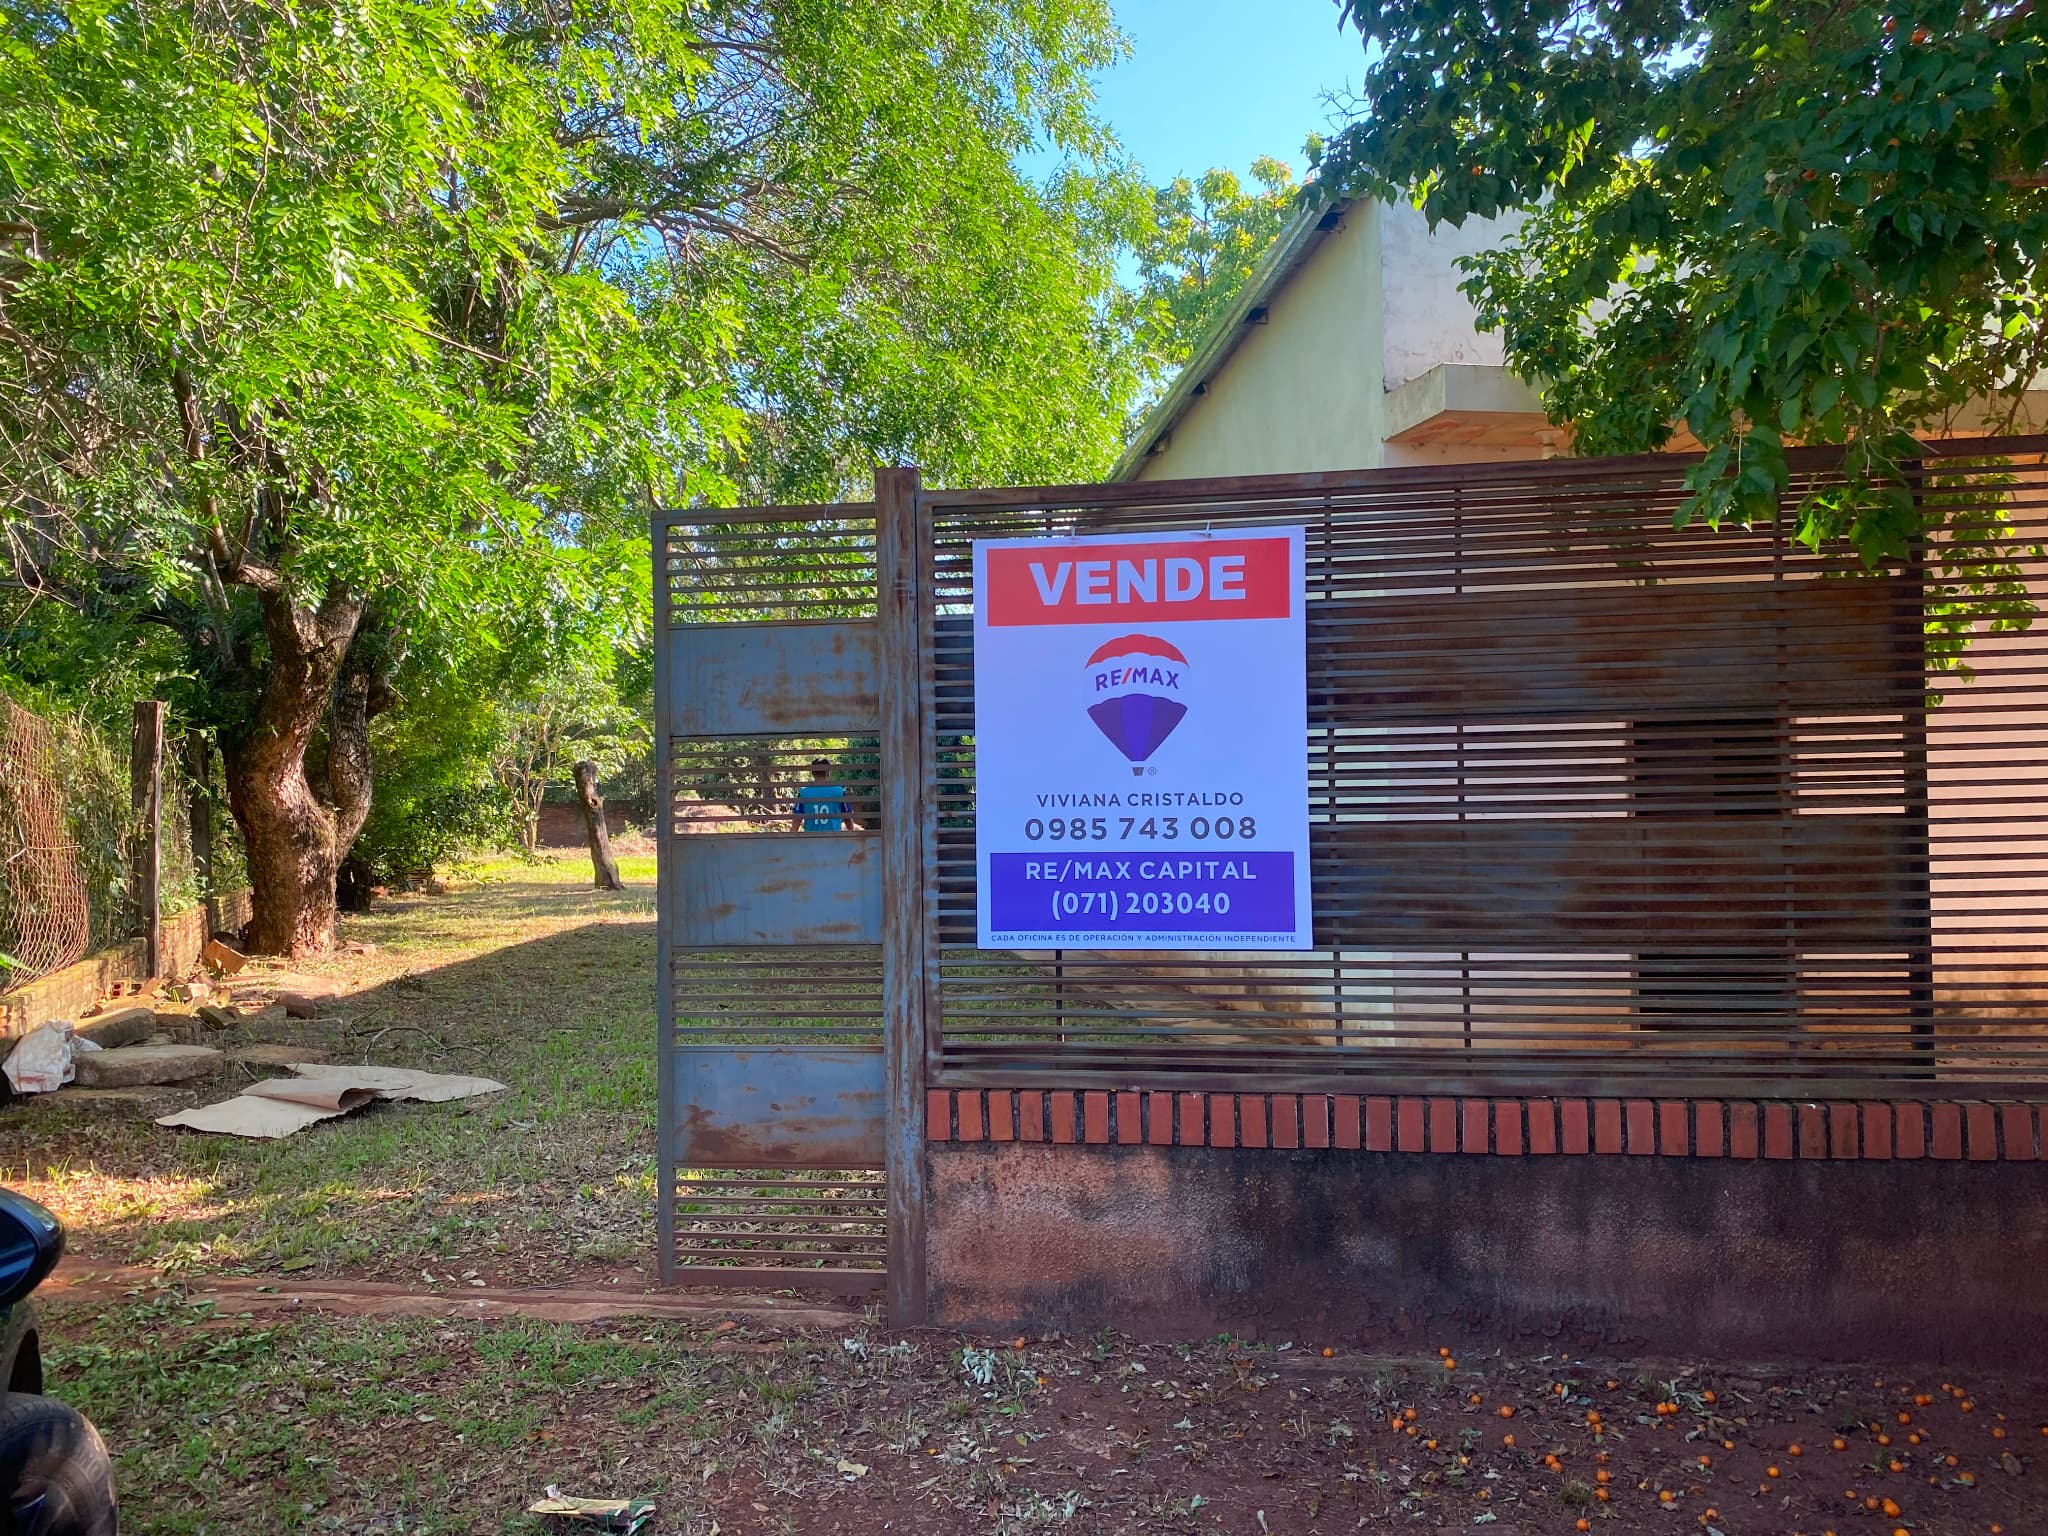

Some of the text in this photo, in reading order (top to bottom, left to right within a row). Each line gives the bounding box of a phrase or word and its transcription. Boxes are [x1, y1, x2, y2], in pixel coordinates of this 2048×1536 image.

[1029, 555, 1246, 606] VENDE
[1095, 667, 1179, 691] RE/MAX
[1037, 792, 1244, 808] VIVIANA CRISTALDO
[1025, 816, 1257, 841] 0985 743 008
[1025, 860, 1257, 883] RE/MAX CAPITAL
[1052, 890, 1231, 921] (071) 203040
[991, 934, 1015, 942] CADA
[1017, 934, 1053, 942] OFICINA
[1055, 934, 1066, 942] ES
[1068, 934, 1081, 942] DE
[1137, 934, 1143, 942] Y
[1224, 934, 1296, 943] INDEPENDIENTE
